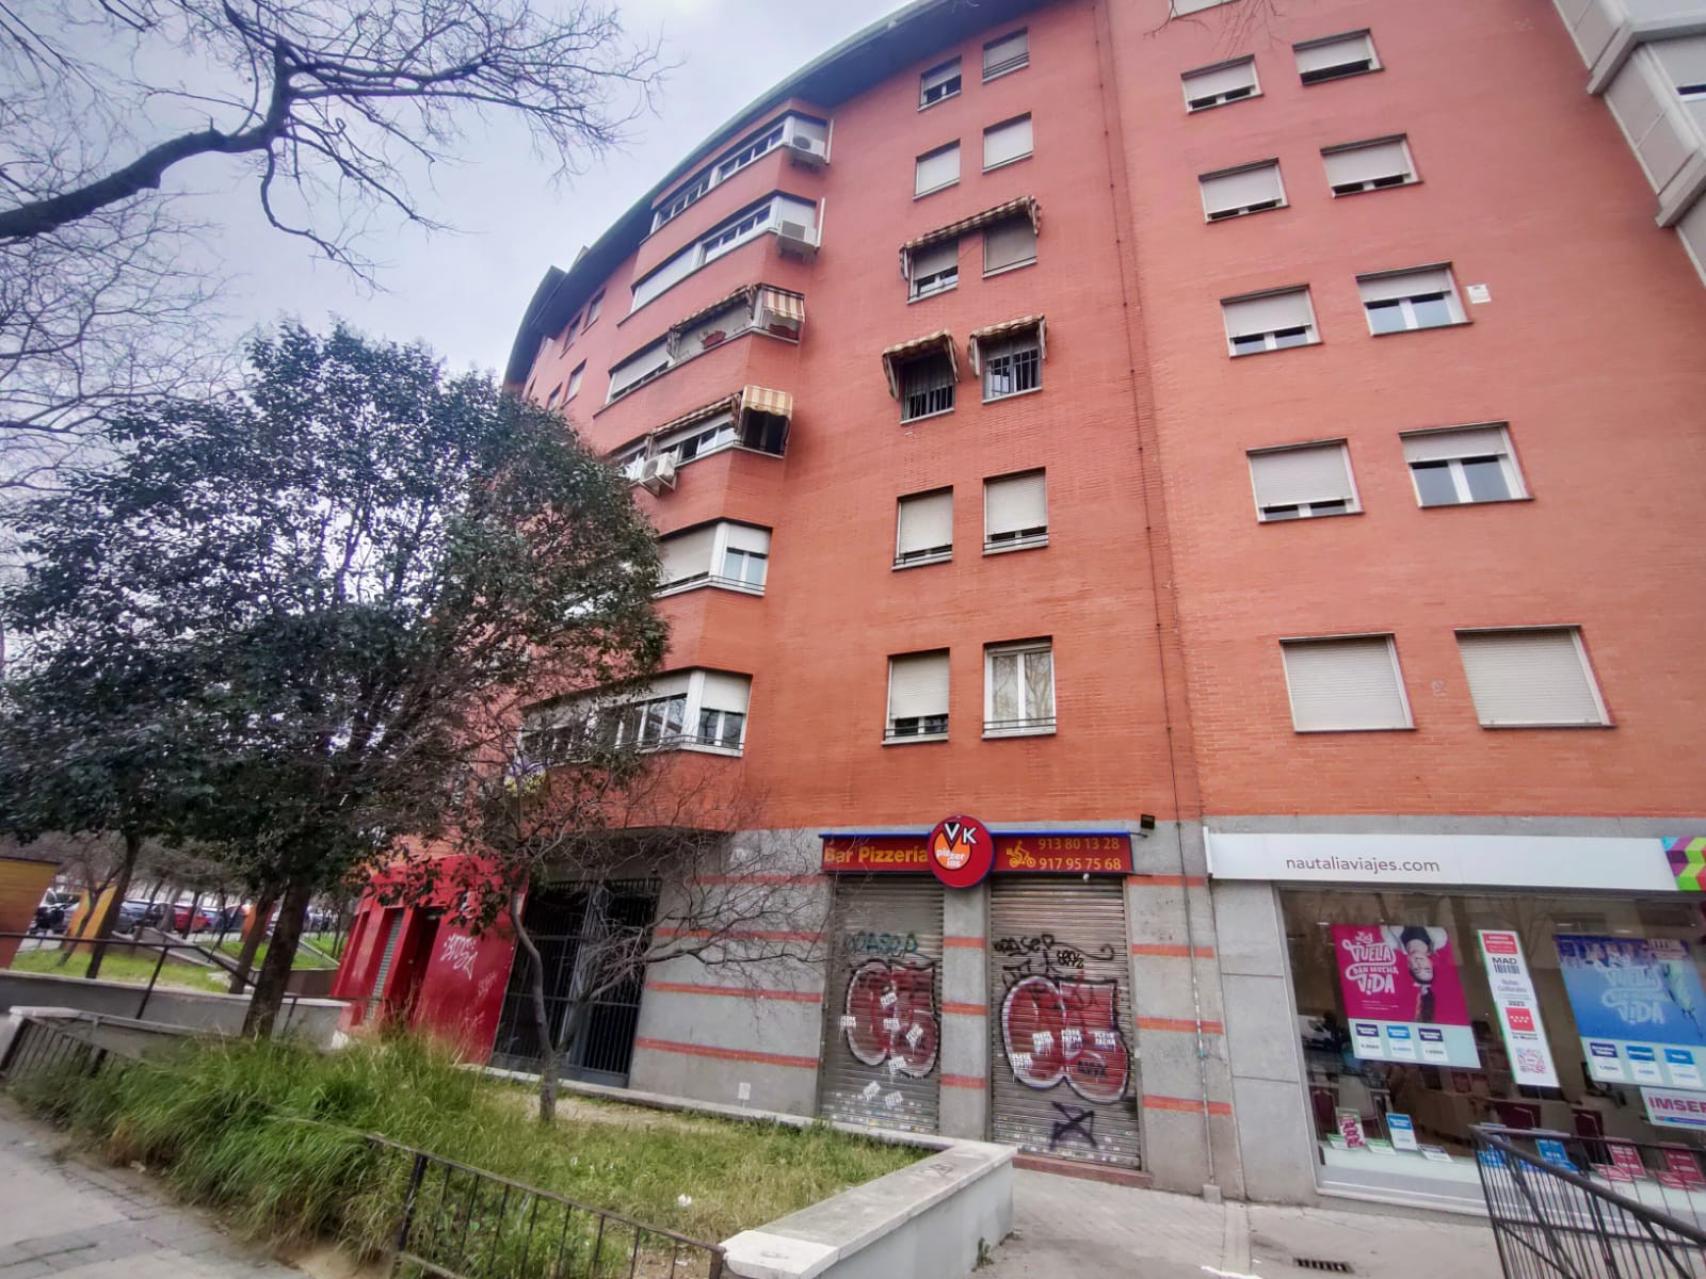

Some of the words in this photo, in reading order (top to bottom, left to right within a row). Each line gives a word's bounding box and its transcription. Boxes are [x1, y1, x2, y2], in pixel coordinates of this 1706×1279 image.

[1038, 837, 1061, 850] 913
[1065, 837, 1081, 850] 80
[1084, 837, 1100, 850] 13
[1103, 836, 1120, 850] 28
[823, 846, 853, 863] Bar
[858, 845, 928, 864] Pizzería
[1039, 857, 1063, 870] 917
[1065, 857, 1082, 870] 95
[1084, 857, 1101, 870] 75
[1104, 857, 1121, 870] 68
[1285, 856, 1440, 875] nautaliaviajes.com
[1492, 957, 1518, 965] MAD
